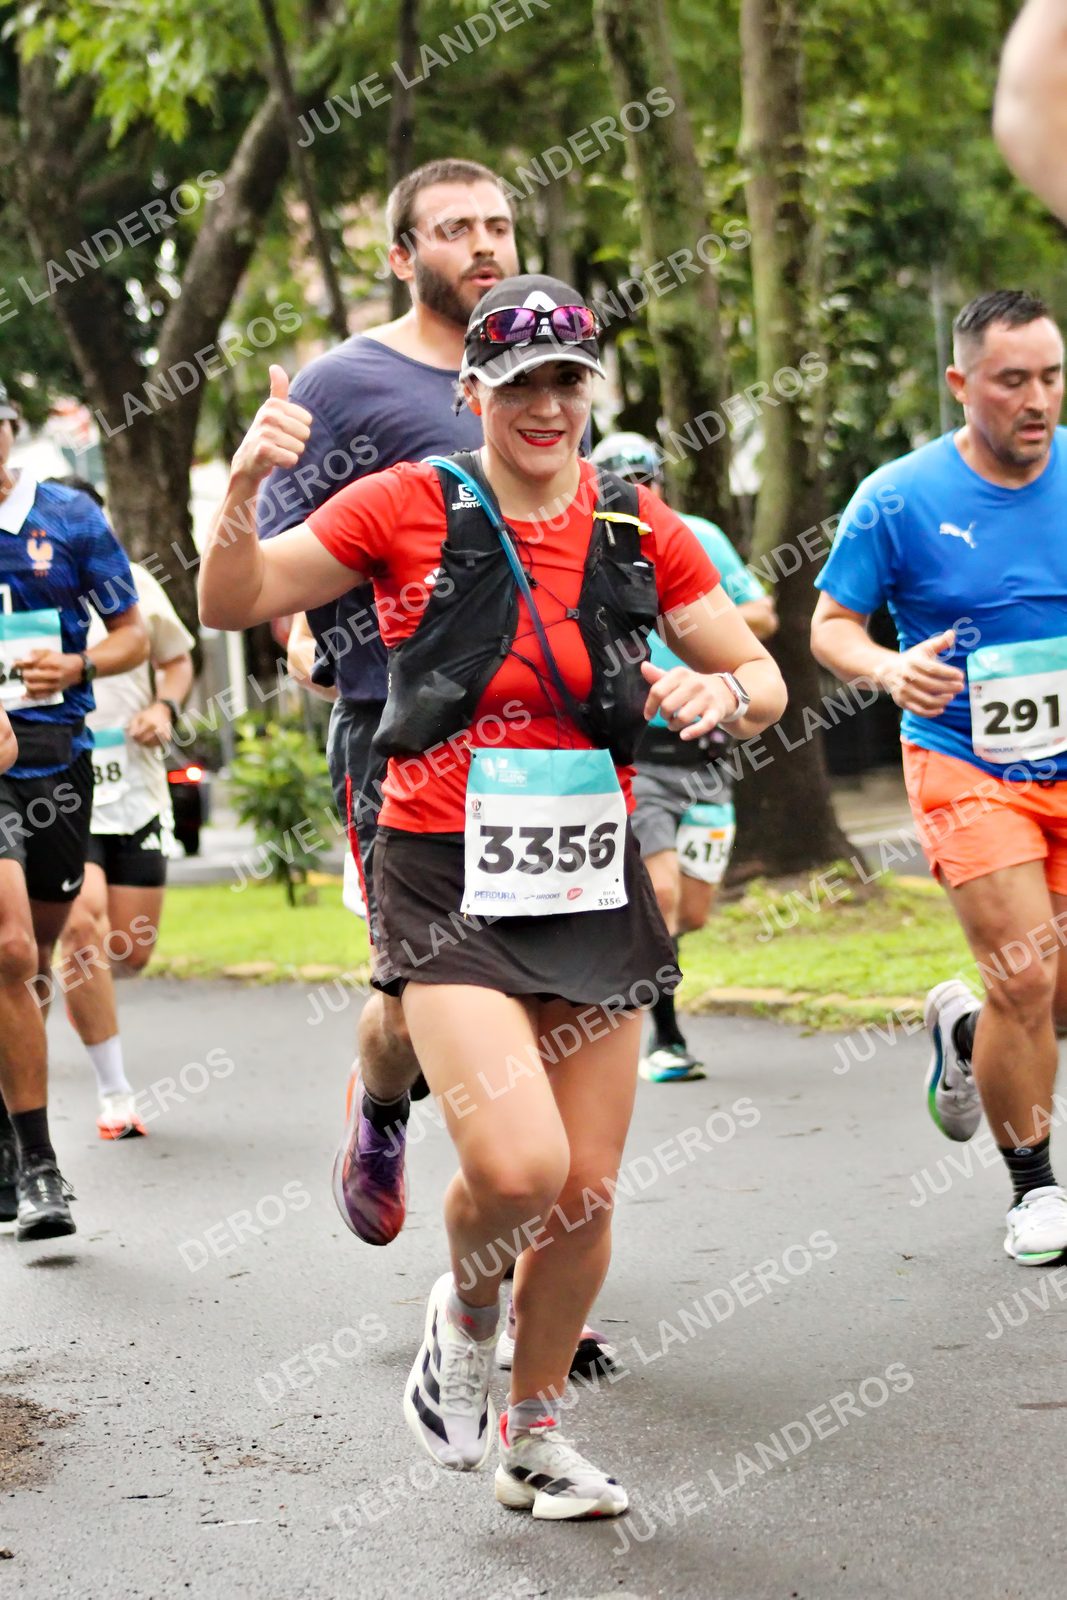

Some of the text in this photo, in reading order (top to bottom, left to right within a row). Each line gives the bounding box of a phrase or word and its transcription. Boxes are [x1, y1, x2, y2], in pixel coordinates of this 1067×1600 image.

[981, 694, 1060, 735] 291
[477, 822, 619, 875] 3356
[474, 890, 517, 900] PERDURA
[598, 897, 622, 907] 3356
